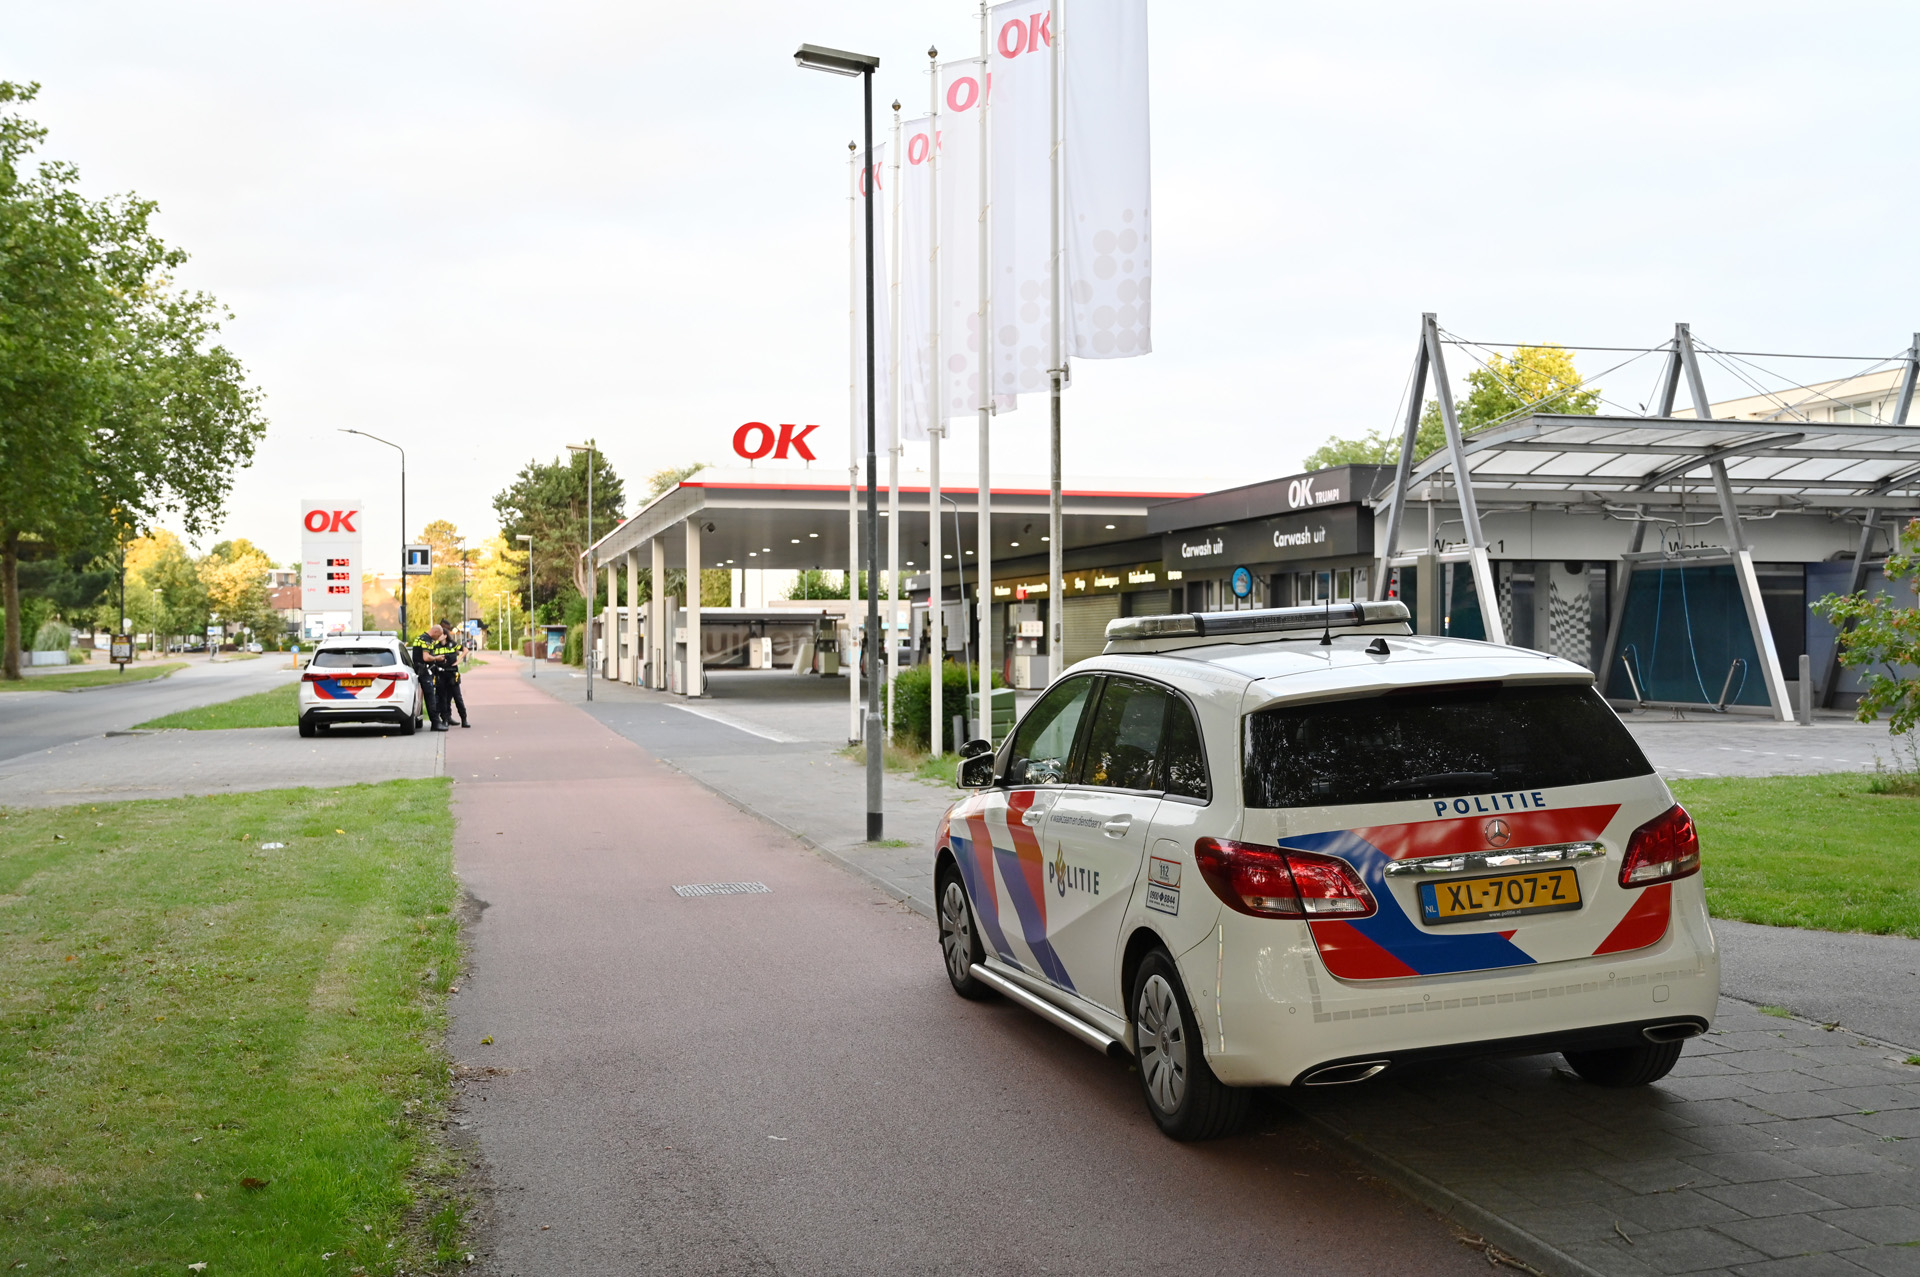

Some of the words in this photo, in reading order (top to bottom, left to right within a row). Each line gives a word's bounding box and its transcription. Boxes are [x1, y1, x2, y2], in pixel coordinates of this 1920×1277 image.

[997, 10, 1051, 59] OK
[946, 72, 991, 112] O
[733, 422, 820, 461] OK
[1288, 478, 1314, 508] OK
[1315, 488, 1340, 504] TRUMPI
[304, 509, 358, 532] OK
[1182, 538, 1212, 558] Carwash
[1213, 537, 1223, 554] uit
[1273, 526, 1311, 547] Carwash
[1313, 526, 1326, 543] uit
[1434, 792, 1546, 817] POLITIE
[1049, 861, 1100, 897] POLITIE
[1447, 875, 1565, 911] XL-707-Z
[1425, 905, 1437, 913] NL
[1489, 909, 1522, 918] www.politie.nl
